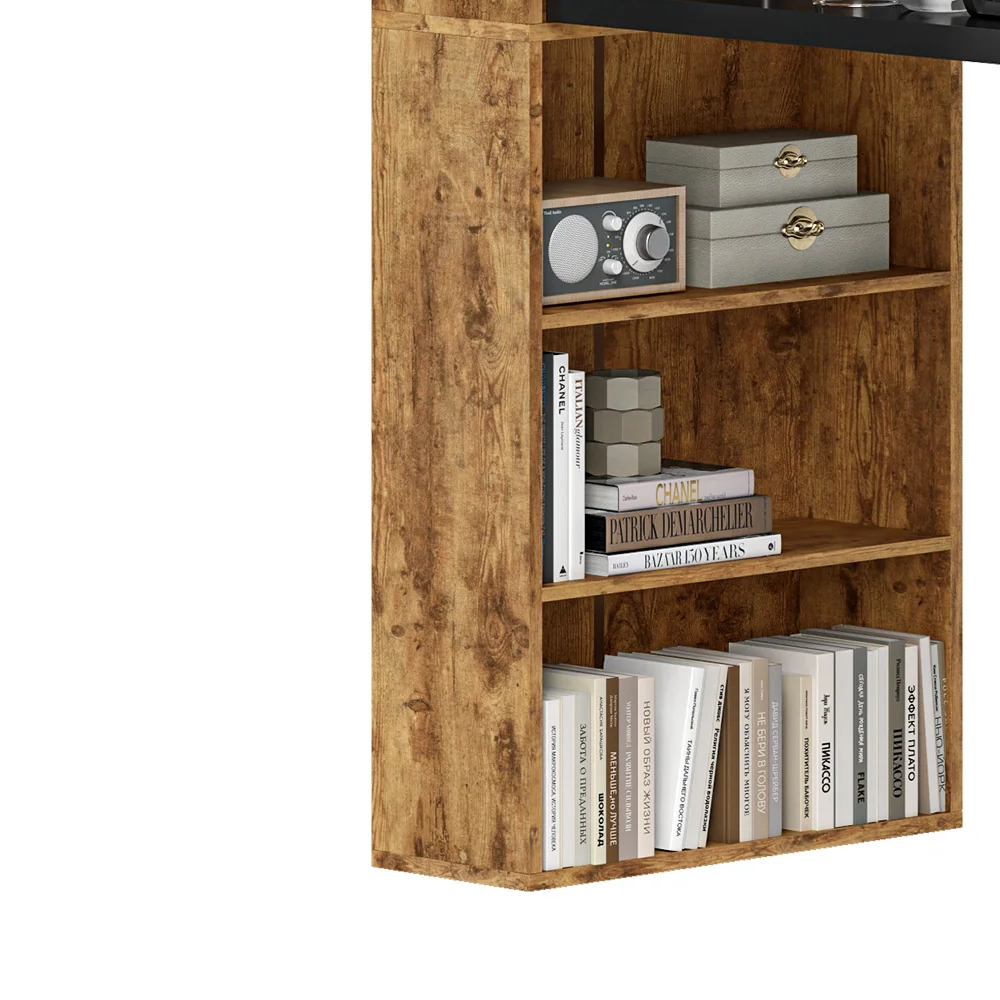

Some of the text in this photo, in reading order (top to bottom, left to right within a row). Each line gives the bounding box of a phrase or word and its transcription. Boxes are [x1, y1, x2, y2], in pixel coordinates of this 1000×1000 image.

[655, 479, 703, 506] CHANEL
[609, 513, 658, 545] PATRICK
[662, 502, 753, 539] DEMARCHELIER
[644, 542, 746, 569] BAZAAR 150 YEARS
[757, 711, 766, 726] НЕ
[771, 701, 779, 729] ДАВИД
[756, 729, 766, 758] БЕРИ
[907, 685, 916, 782] ЭФФЕКТ ПЛАТО
[643, 701, 652, 835] НОВЫЙ ОБРАЗ ЖИЗНИ
[757, 760, 766, 768] В
[821, 742, 831, 793] ПИКАССО
[892, 728, 903, 798] ПИКАССО
[578, 723, 587, 845] ЗАБОТА О ПРЕДАННЫХ
[679, 765, 690, 803] ДАЛЬНЕГО
[756, 769, 766, 814] ГОЛОВУ
[857, 771, 865, 804] FLAKE
[597, 793, 605, 847] ШОКОЛАД
[609, 811, 617, 846] ЛУЧШЕ
[675, 804, 685, 837] ВОСТОКА
